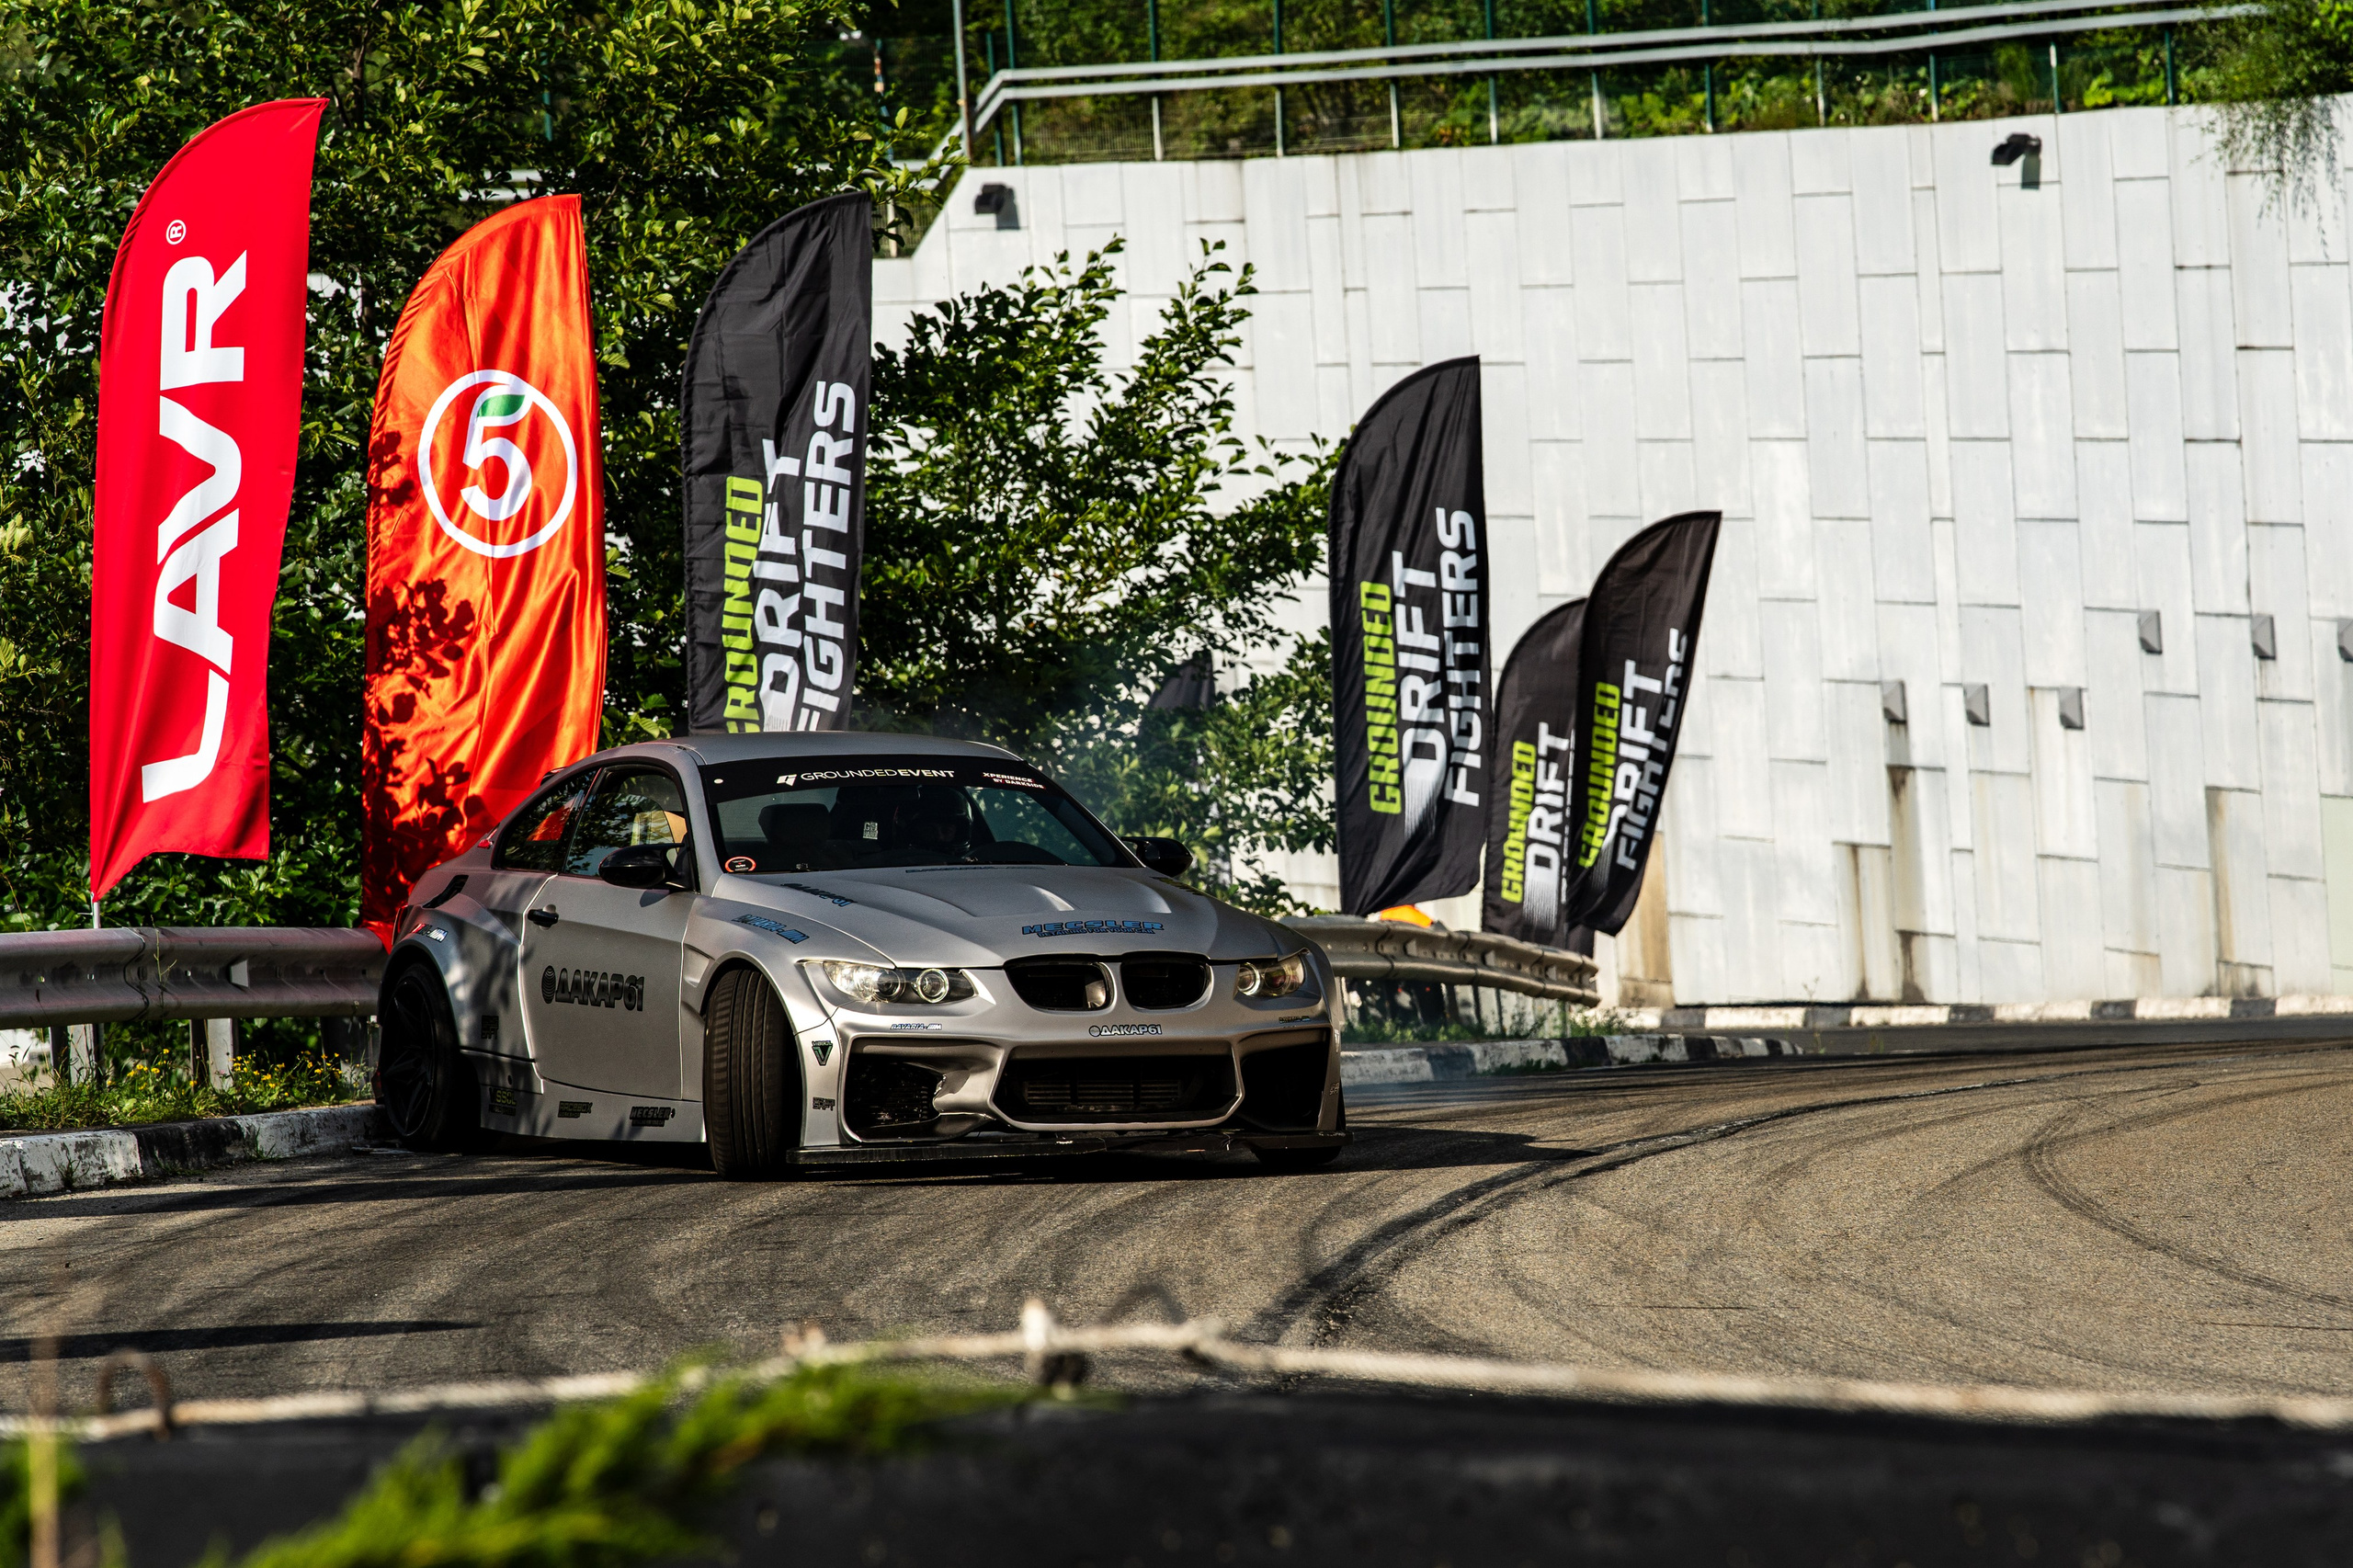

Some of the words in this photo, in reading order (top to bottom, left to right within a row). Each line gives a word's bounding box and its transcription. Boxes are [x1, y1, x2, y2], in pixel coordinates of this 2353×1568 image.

[722, 475, 764, 733] ROUNDED
[752, 438, 801, 733] DRIFT
[1360, 581, 1402, 815] GROUNDED
[1392, 551, 1448, 833] DRIFT
[1436, 506, 1482, 807] FIGHTERS
[983, 772, 1033, 783] XPERIENCE
[1501, 740, 1537, 903] GROUNDED
[1523, 722, 1570, 922] DRIFT
[1021, 920, 1165, 935] MECSLER
